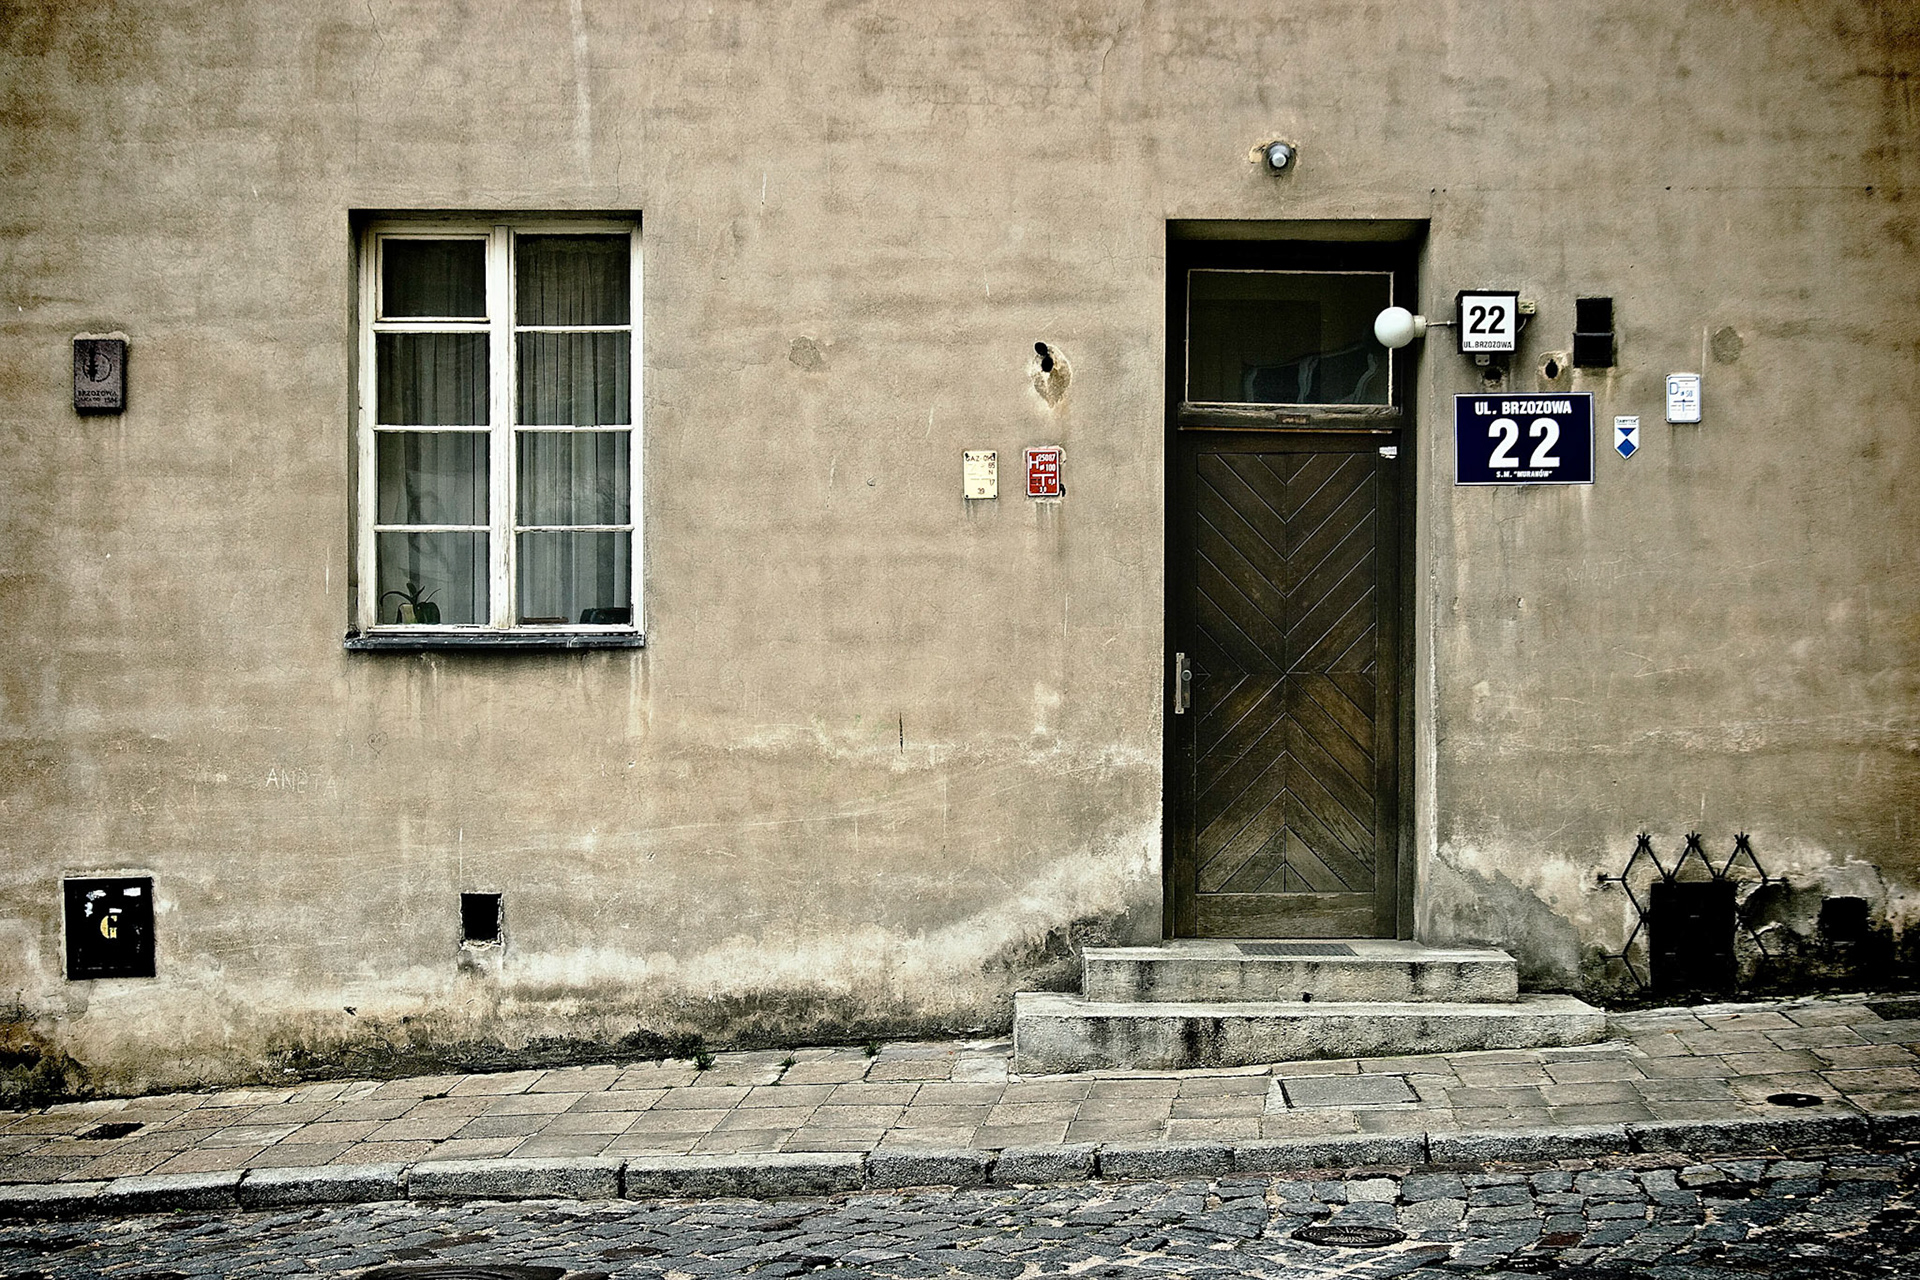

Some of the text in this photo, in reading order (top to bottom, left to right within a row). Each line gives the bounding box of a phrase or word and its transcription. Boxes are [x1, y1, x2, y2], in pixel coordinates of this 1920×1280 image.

[1469, 305, 1505, 334] 22
[1475, 400, 1572, 415] UL. BRZOZOWA
[1488, 418, 1560, 468] 22
[100, 915, 118, 939] G
